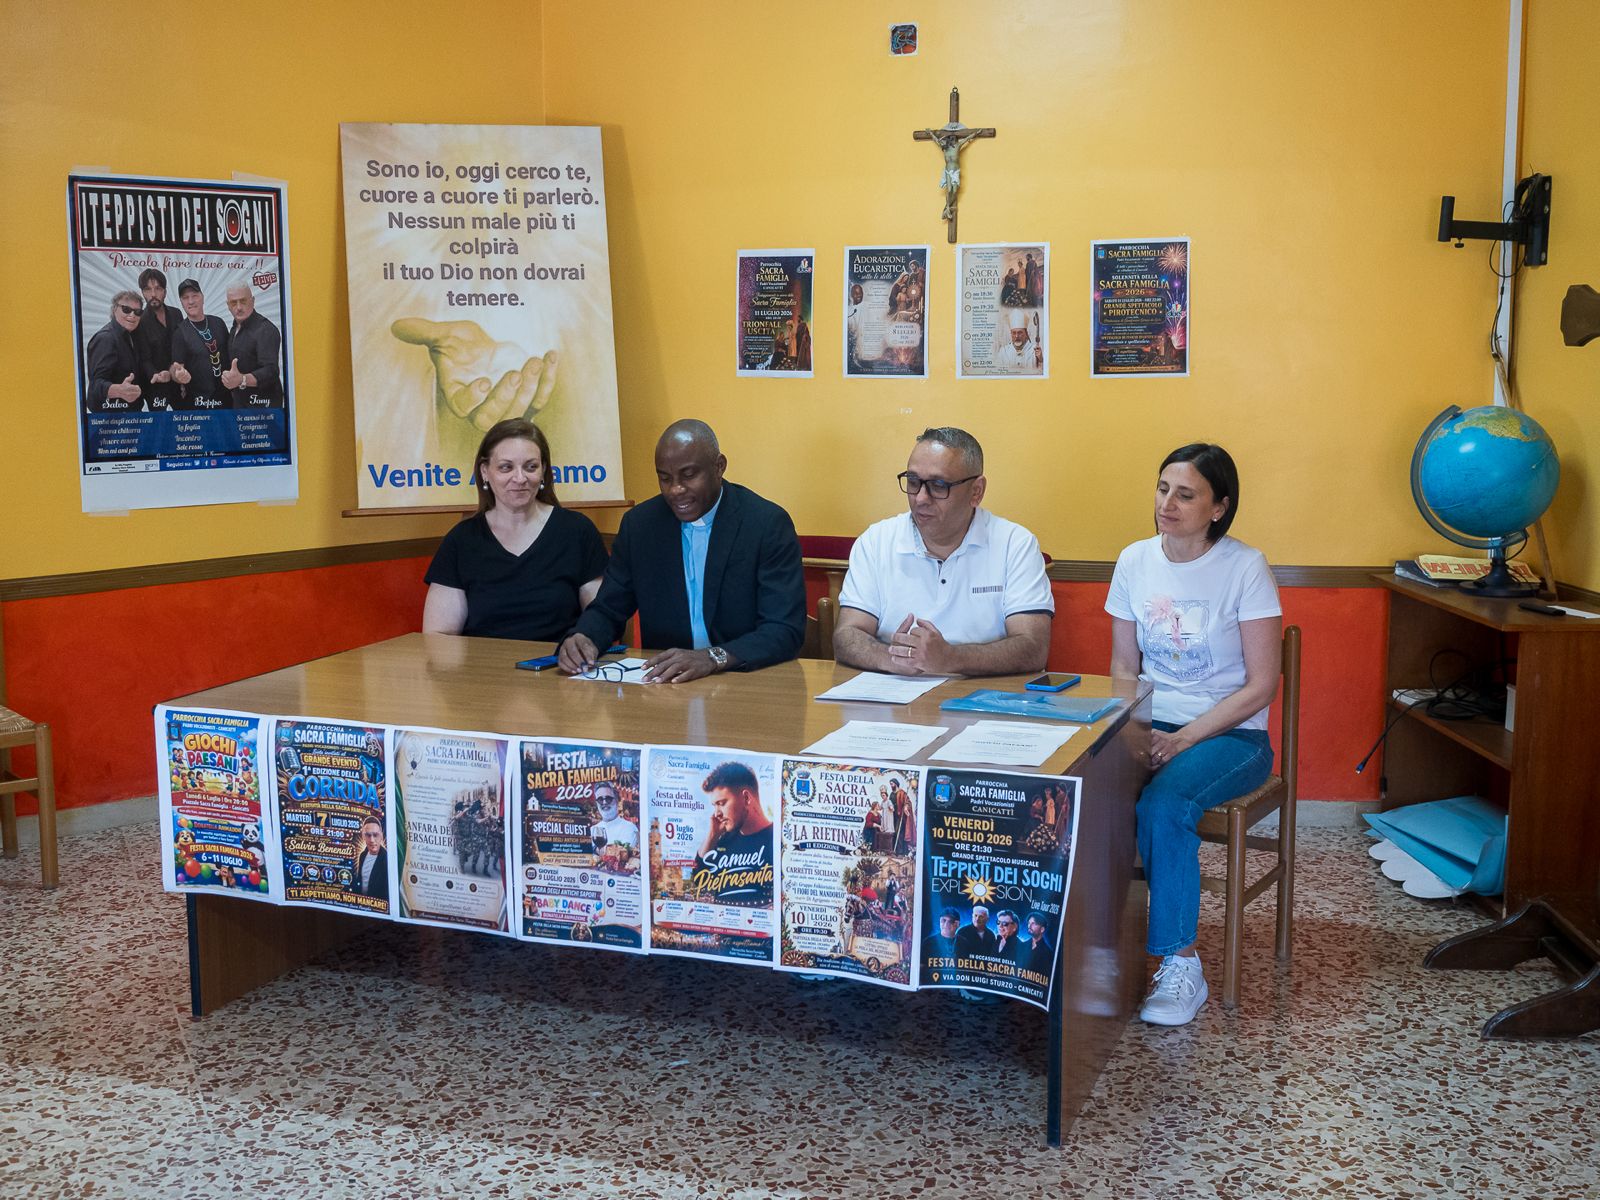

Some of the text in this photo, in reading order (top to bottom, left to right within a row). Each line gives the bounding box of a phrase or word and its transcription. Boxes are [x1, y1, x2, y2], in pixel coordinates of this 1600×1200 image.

[367, 160, 590, 183] Sono io, oggi cerco te,
[360, 188, 599, 208] cuore a cuore ti parlerò.
[89, 192, 175, 247] TEPPISTI
[181, 197, 211, 243] DEI
[215, 198, 271, 253] SOGNI
[388, 212, 575, 233] Nessun male più ti
[450, 238, 518, 258] colpirà
[1108, 250, 1131, 258] SACRA
[109, 253, 222, 271] Piccolo fiore dove
[383, 263, 585, 280] il tuo Dio non dovrai
[969, 268, 999, 277] SACRA
[1099, 279, 1170, 289] SACRA FAMIGLIA
[447, 291, 524, 306] temere.
[1108, 308, 1157, 316] PIROTECNICO
[102, 394, 271, 408] Salvo Beppe Tony
[368, 463, 461, 488] Venite
[173, 713, 249, 727] PARROCCHIA SACRA FAMIGLIA
[184, 733, 237, 757] GIOCHI
[294, 730, 367, 749] SACRA FAMIGLIA
[303, 755, 358, 768] GRANDE EVENTO
[425, 745, 497, 763] SACRA FAMIGLIA
[547, 750, 587, 771] FESTA
[187, 751, 239, 773] PAESANI
[668, 760, 711, 770] Sacra Famiglia
[313, 767, 359, 779] EDIZIONE DELLA
[527, 766, 617, 789] SACRA FAMIGLIA
[820, 772, 875, 785] FESTA DELLA
[825, 782, 868, 796] SACRA
[975, 779, 1008, 788] PARROCCHIA
[288, 774, 380, 810] CORRIDA
[555, 784, 593, 801] 2026
[655, 790, 694, 800] festa della
[959, 785, 1026, 802] SACRA FAMIGLIA
[651, 799, 705, 811] Sacra Famiglia
[818, 793, 872, 808] FAMIGLIA
[985, 799, 1015, 808] Vocazionisti
[832, 806, 856, 815] 2026
[972, 806, 1014, 816] CANICATTÌ
[285, 812, 347, 827] MARTEDÌ 7 LUGLIO
[943, 816, 995, 832] VENERDÌ
[310, 828, 344, 838] ORE 21:00
[406, 822, 438, 834] ANFARA
[532, 821, 588, 836] SPECIAL GUEST
[665, 823, 694, 839] 9 luglio
[793, 824, 857, 847] LA RIETINA
[932, 828, 1013, 846] 10 LUGLIO 2026
[190, 844, 253, 860] FESTA SACRA FAMIGLIA 2026
[289, 839, 353, 855] Salvin Benenati
[812, 842, 840, 850] EDIZIONE
[954, 842, 993, 853] ORE 21:30
[201, 853, 243, 867] 6 11 LUGLIO
[703, 845, 765, 873] Samuel
[951, 851, 1040, 868] GRANDE SPETTACOLO MUSICALE
[410, 861, 459, 875] SACRA FAMIGLIA
[786, 866, 813, 875] CARRETTI
[931, 855, 990, 881] TEPPISTI
[994, 866, 1018, 885] DEI
[543, 874, 562, 882] LUGLIO
[694, 863, 773, 900] Pietrasanta
[561, 889, 579, 897] ANTICHI
[343, 895, 356, 903] NON
[357, 896, 387, 910] MANCARE!
[537, 898, 591, 914] BABY DANCE
[791, 912, 838, 925] 10 LUGLIO
[976, 954, 1001, 963] OCCASIONE
[1001, 958, 1016, 966] DELLA
[928, 957, 1049, 986] FESTA DELLA SACRA FAMIGLIA
[956, 974, 970, 982] DON
[971, 975, 989, 984] LUIGI
[990, 979, 1013, 989] STURZO
